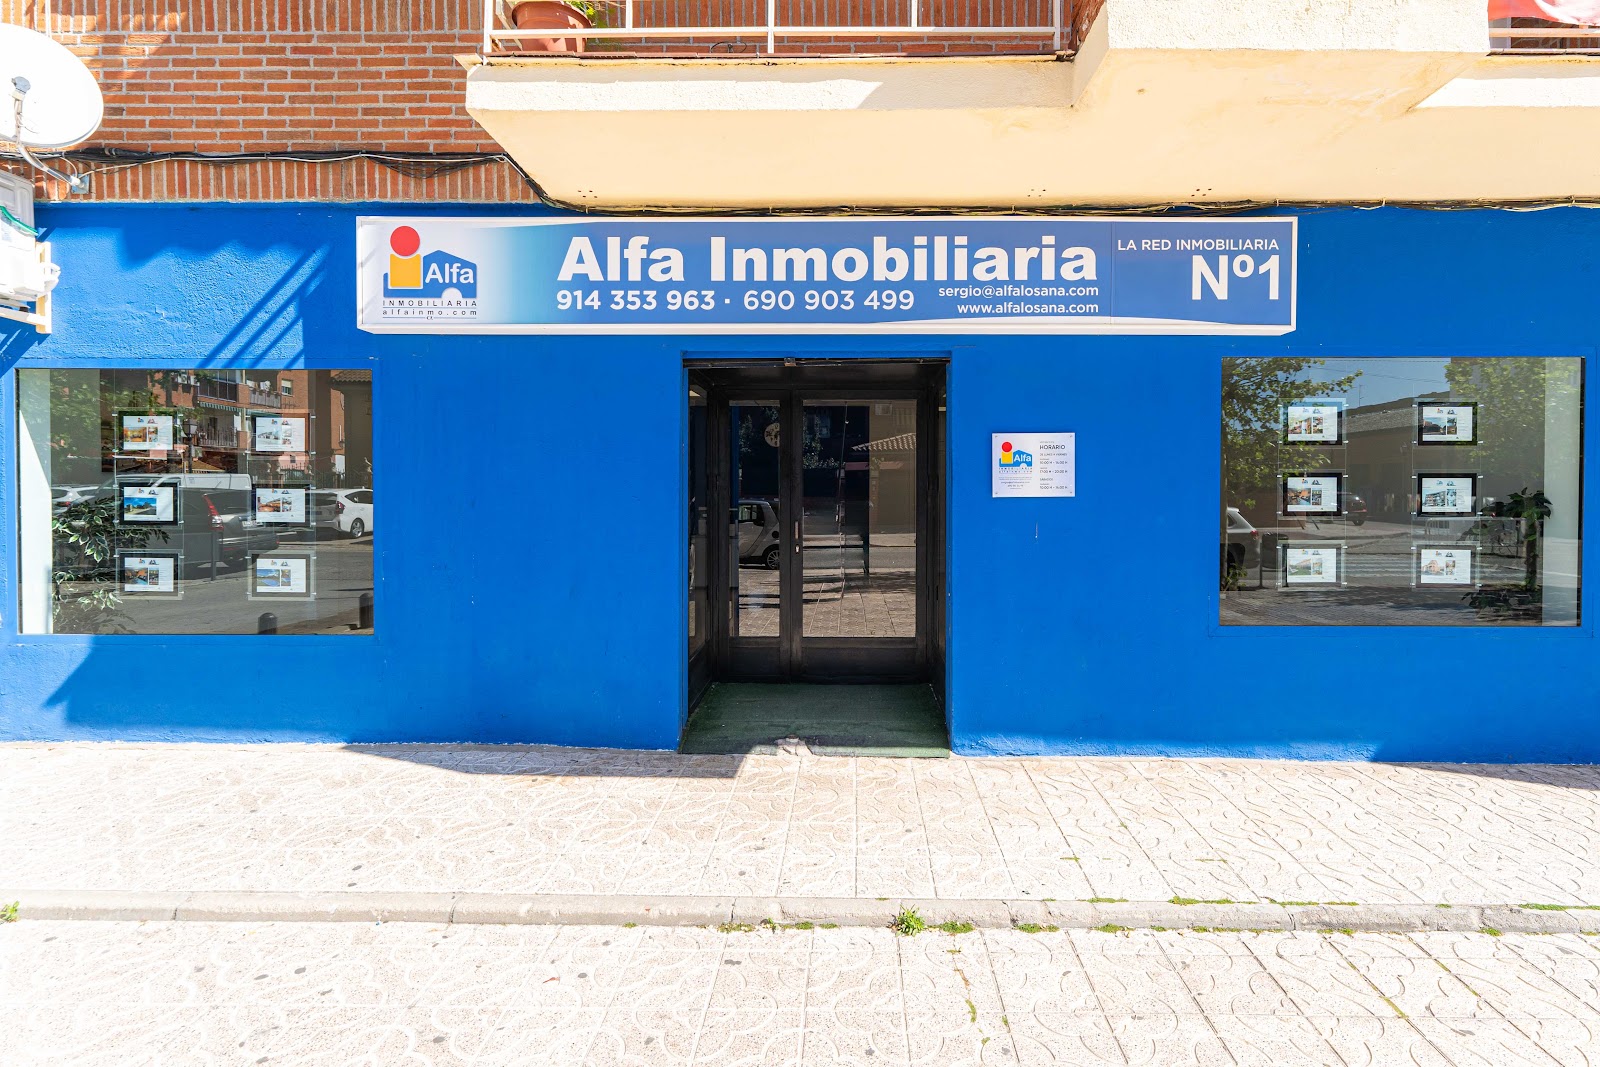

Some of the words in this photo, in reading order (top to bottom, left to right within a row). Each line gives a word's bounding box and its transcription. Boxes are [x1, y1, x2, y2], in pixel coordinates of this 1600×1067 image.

[1117, 239, 1138, 251] LA
[1141, 239, 1172, 251] RED
[1176, 239, 1280, 251] INMOBILIARIA
[557, 236, 684, 282] Alfa
[710, 236, 1098, 282] Inmobiliaria
[425, 262, 475, 284] Alfa
[938, 284, 1099, 299] sergio@alfalosana.com
[556, 290, 601, 310] 914
[610, 290, 657, 310] 353
[666, 290, 715, 310] 963
[743, 290, 795, 311] 690
[804, 290, 855, 311] 903
[863, 290, 915, 311] 499
[957, 301, 1099, 314] www.alfalosana.com
[383, 308, 477, 316] alfainmo.com
[1014, 454, 1031, 462] Alfa
